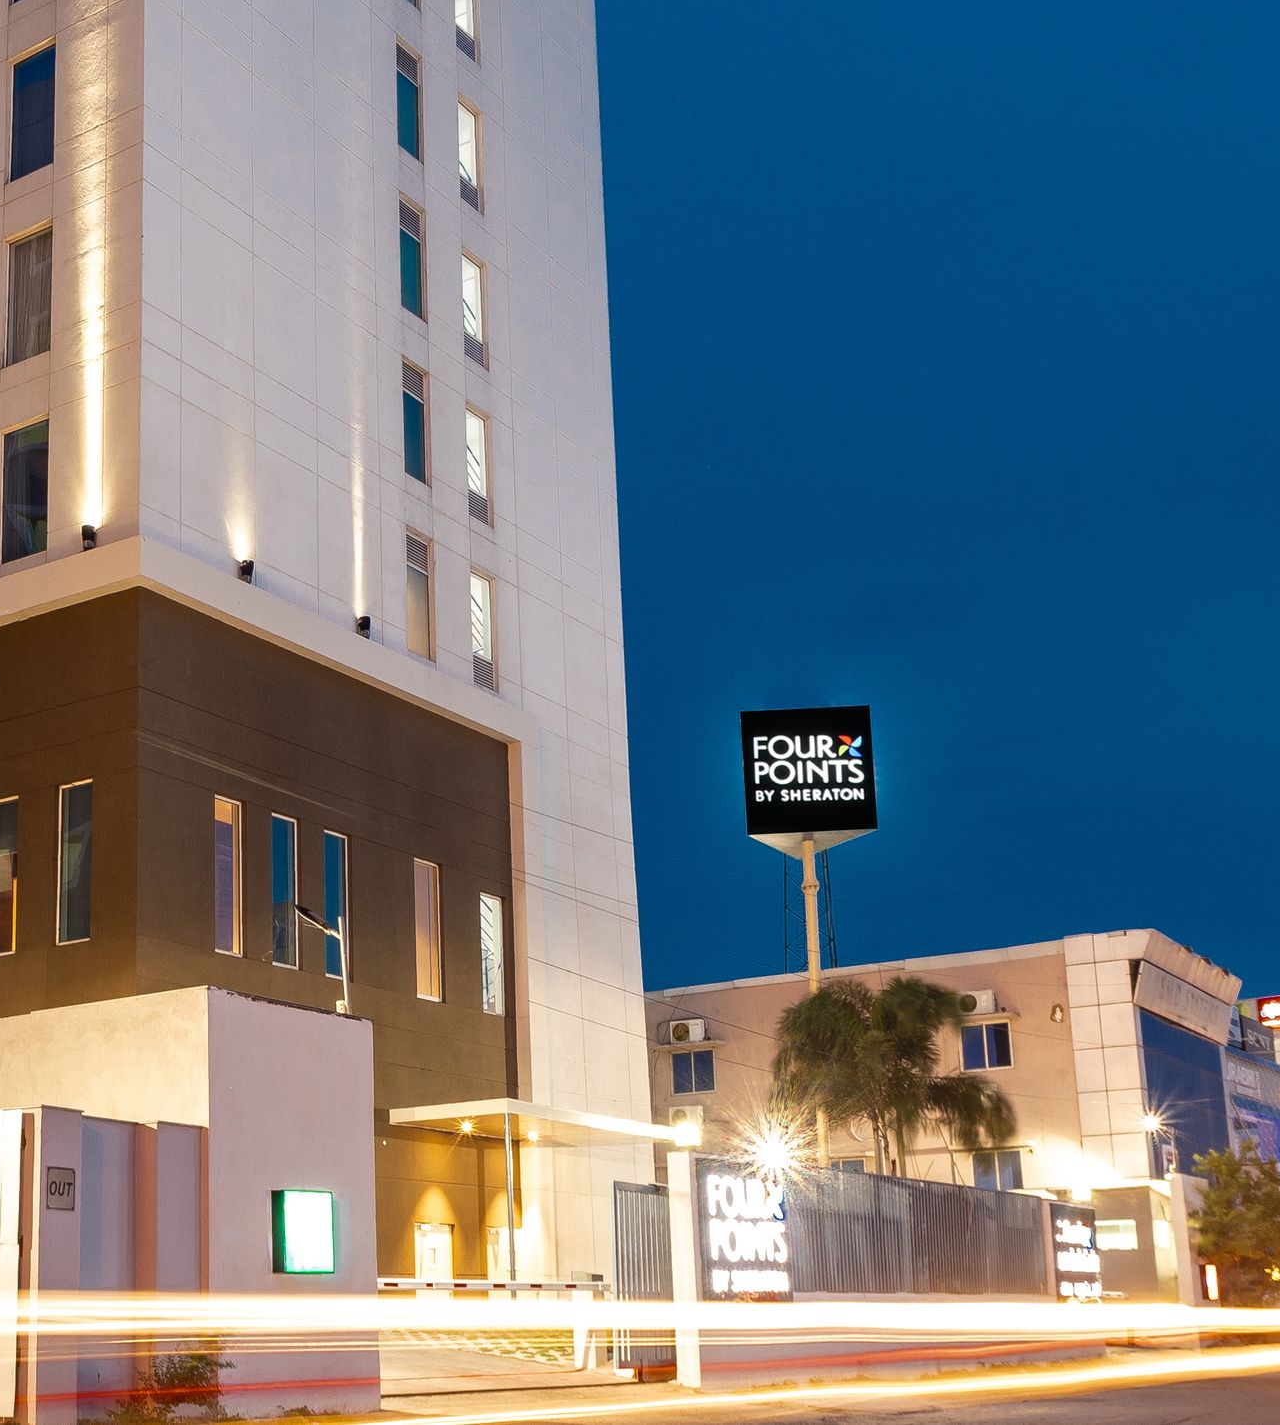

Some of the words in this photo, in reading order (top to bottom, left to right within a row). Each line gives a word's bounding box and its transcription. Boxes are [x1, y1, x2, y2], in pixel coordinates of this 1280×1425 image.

[752, 735, 838, 759] FOUR
[754, 759, 865, 785] POINTS
[755, 789, 775, 802] BY
[780, 788, 865, 802] SHERATON
[49, 1181, 73, 1197] OUT
